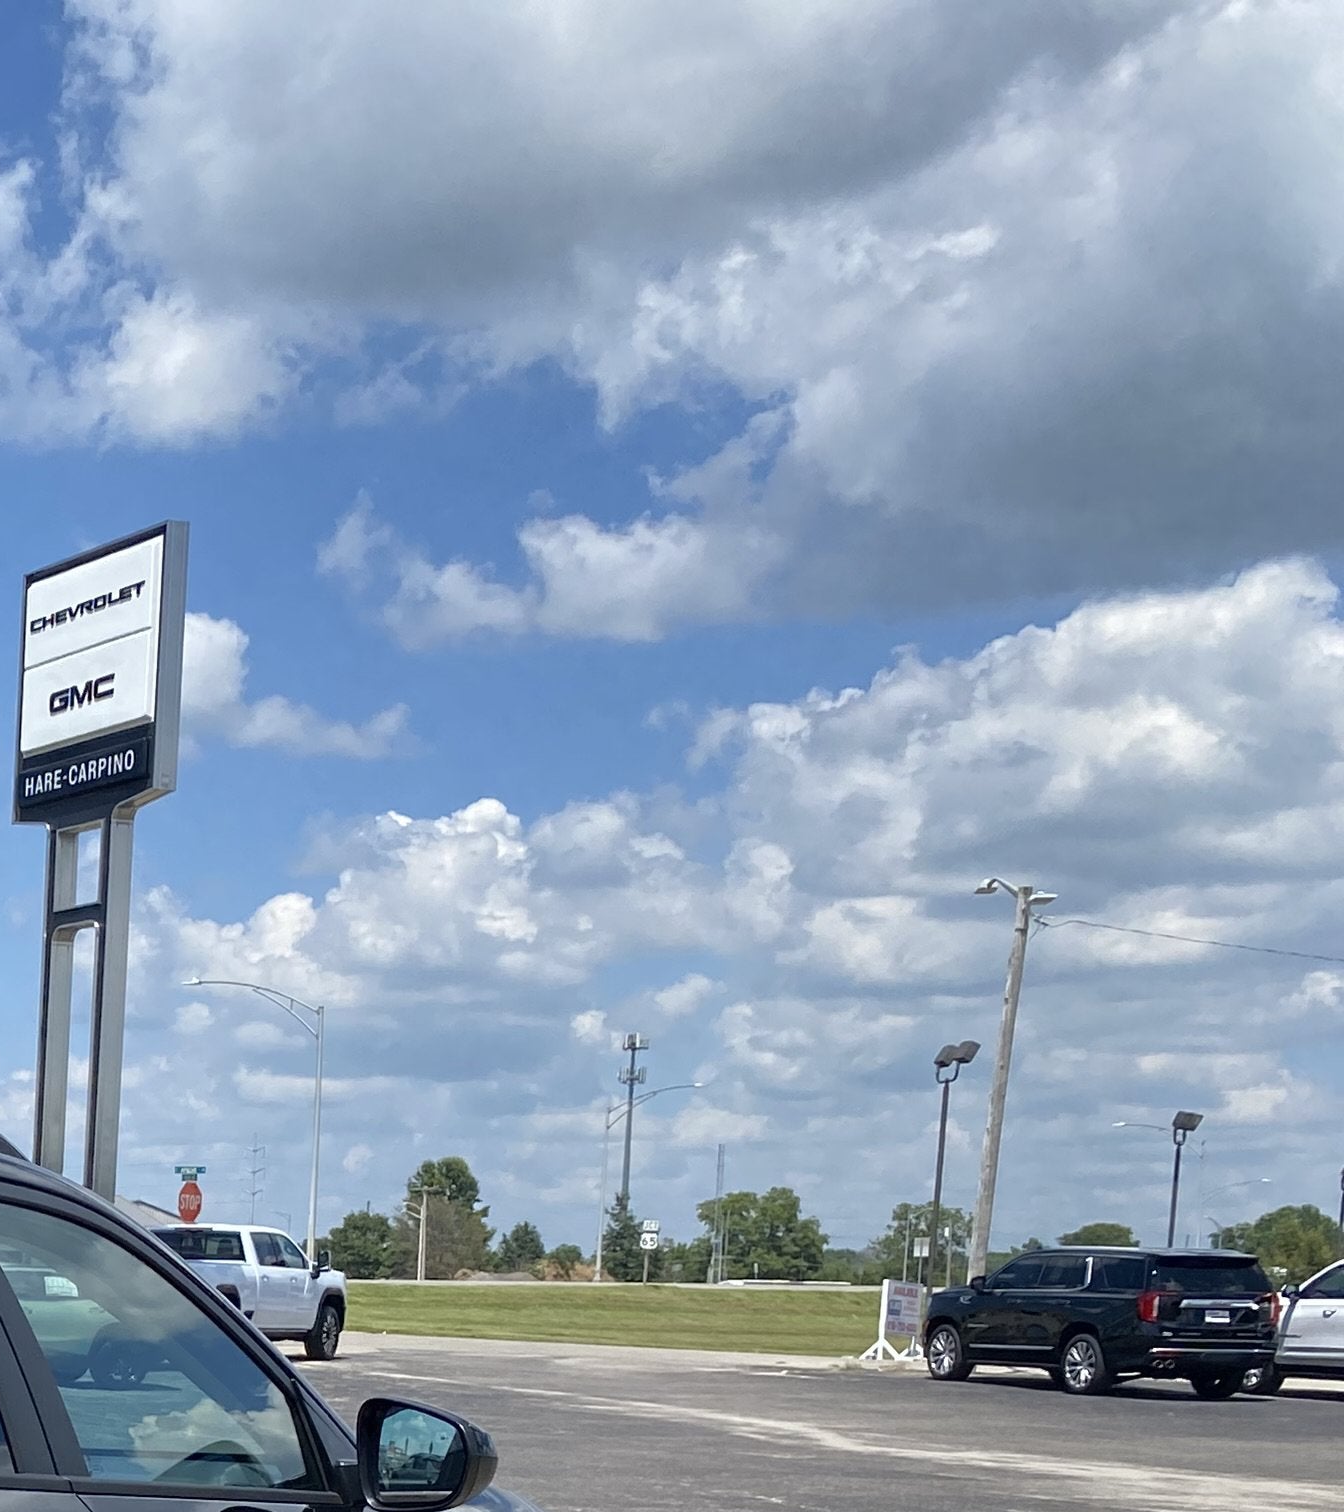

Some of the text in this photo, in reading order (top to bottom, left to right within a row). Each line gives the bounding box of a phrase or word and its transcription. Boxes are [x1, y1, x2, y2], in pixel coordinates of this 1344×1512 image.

[29, 580, 146, 634] CHEVROLET
[49, 673, 116, 715] GMC
[24, 748, 135, 797] HARE-CARPINO
[180, 1194, 201, 1210] STOP
[642, 1236, 656, 1247] 65
